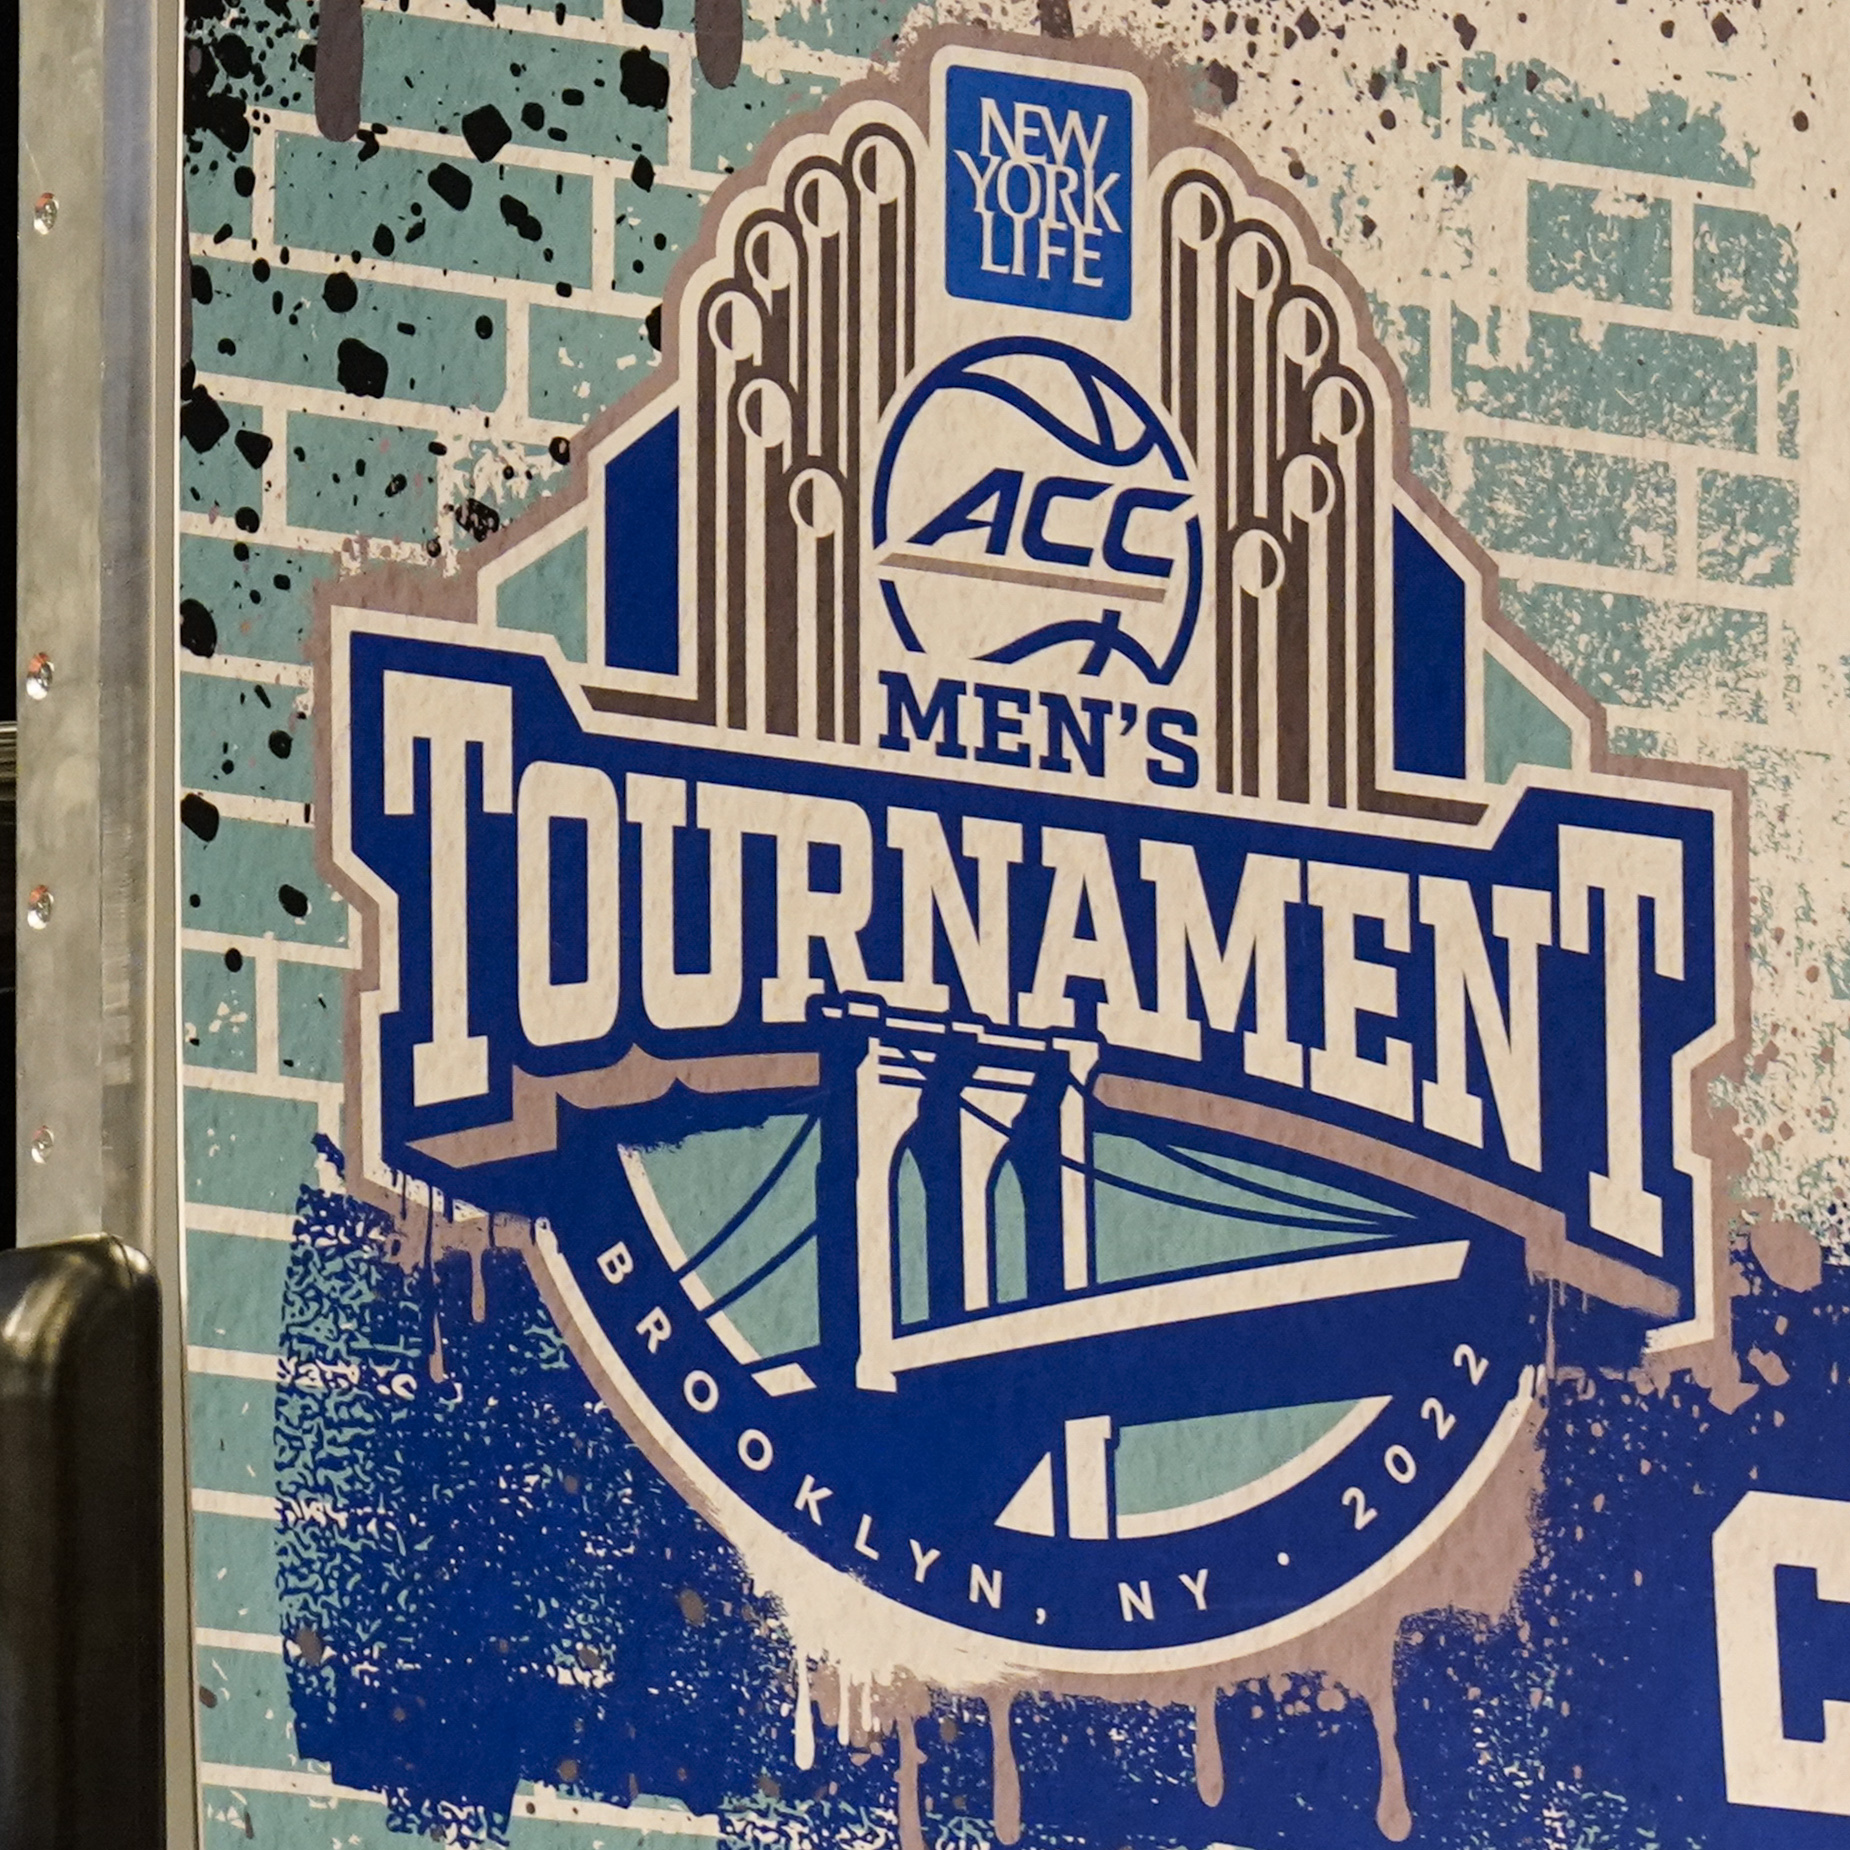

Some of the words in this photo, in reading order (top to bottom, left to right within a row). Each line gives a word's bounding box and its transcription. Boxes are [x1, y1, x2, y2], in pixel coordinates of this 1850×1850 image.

[979, 96, 1109, 168] NEW
[953, 149, 1123, 236] YORK
[980, 207, 1104, 288] LIFE
[906, 467, 1195, 579] ACC
[877, 669, 1199, 790] MEN'S
[381, 668, 1684, 1257] TOURNAMENT
[594, 1242, 1048, 1625] BROOKLYN,
[1119, 1566, 1214, 1623] NY
[1341, 1342, 1488, 1530] 2022
